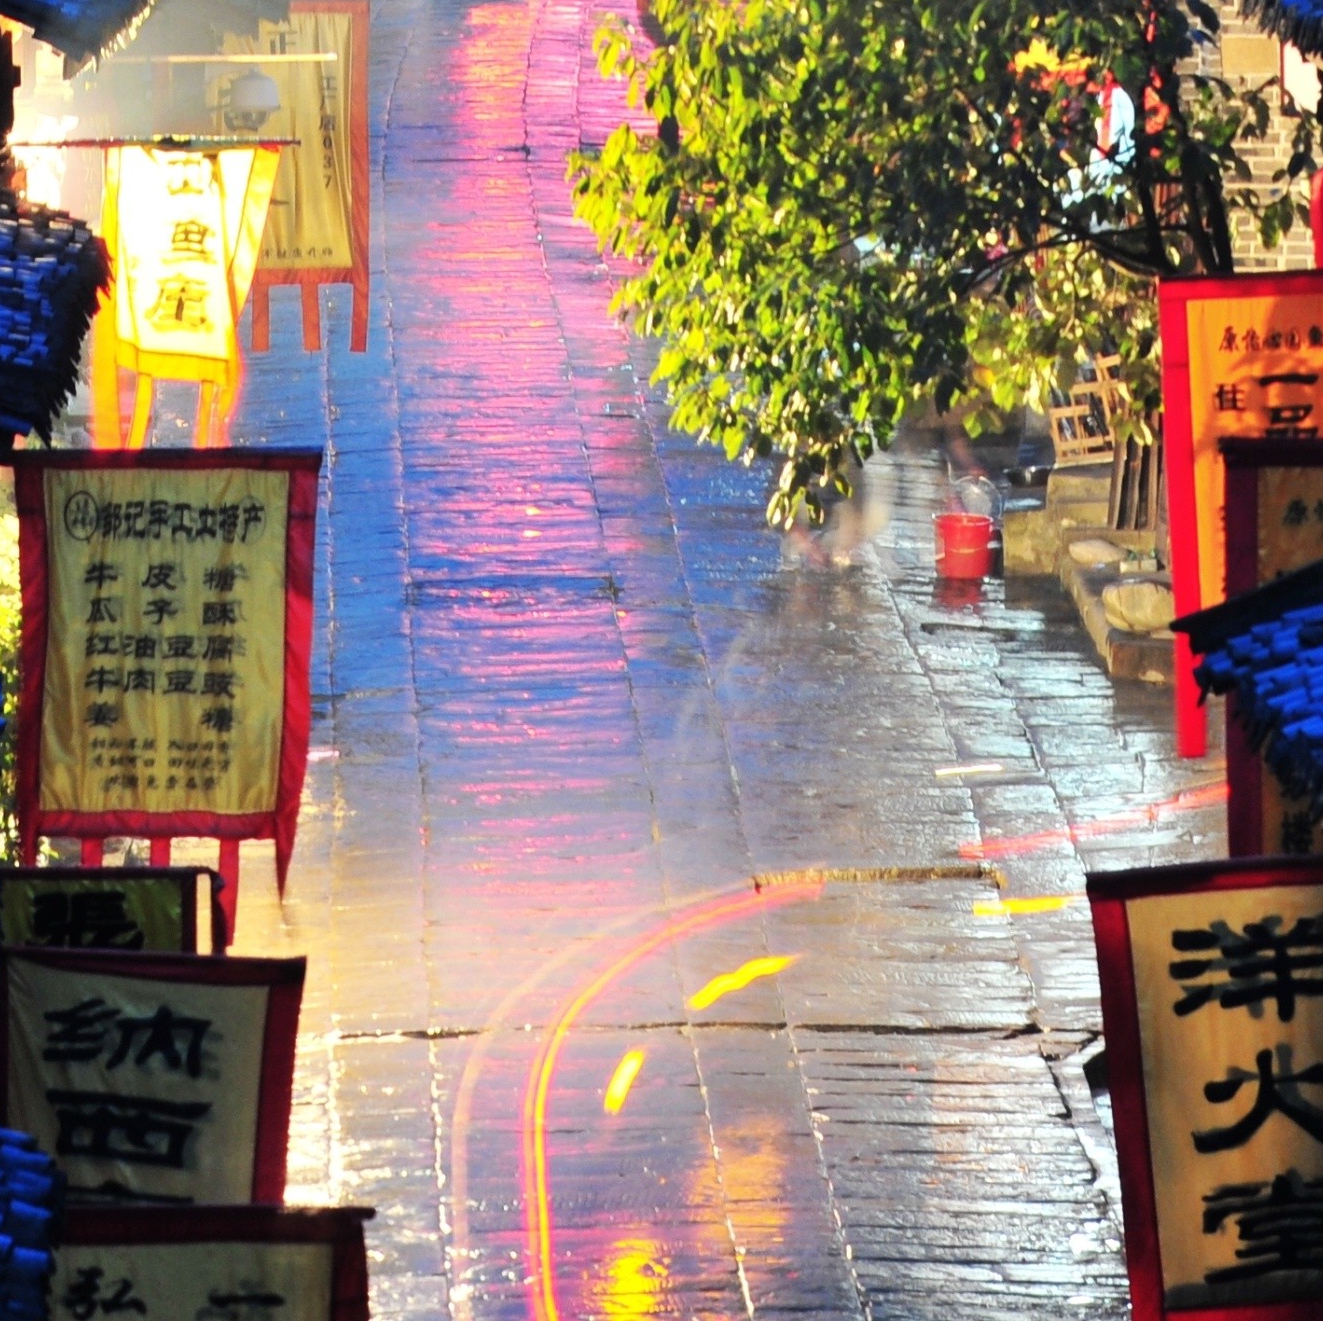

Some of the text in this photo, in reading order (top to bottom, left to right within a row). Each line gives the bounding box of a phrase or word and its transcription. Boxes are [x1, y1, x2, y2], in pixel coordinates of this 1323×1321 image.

[84, 633, 235, 663] 红油豆腐
[84, 668, 236, 699] 牛肉豆豉
